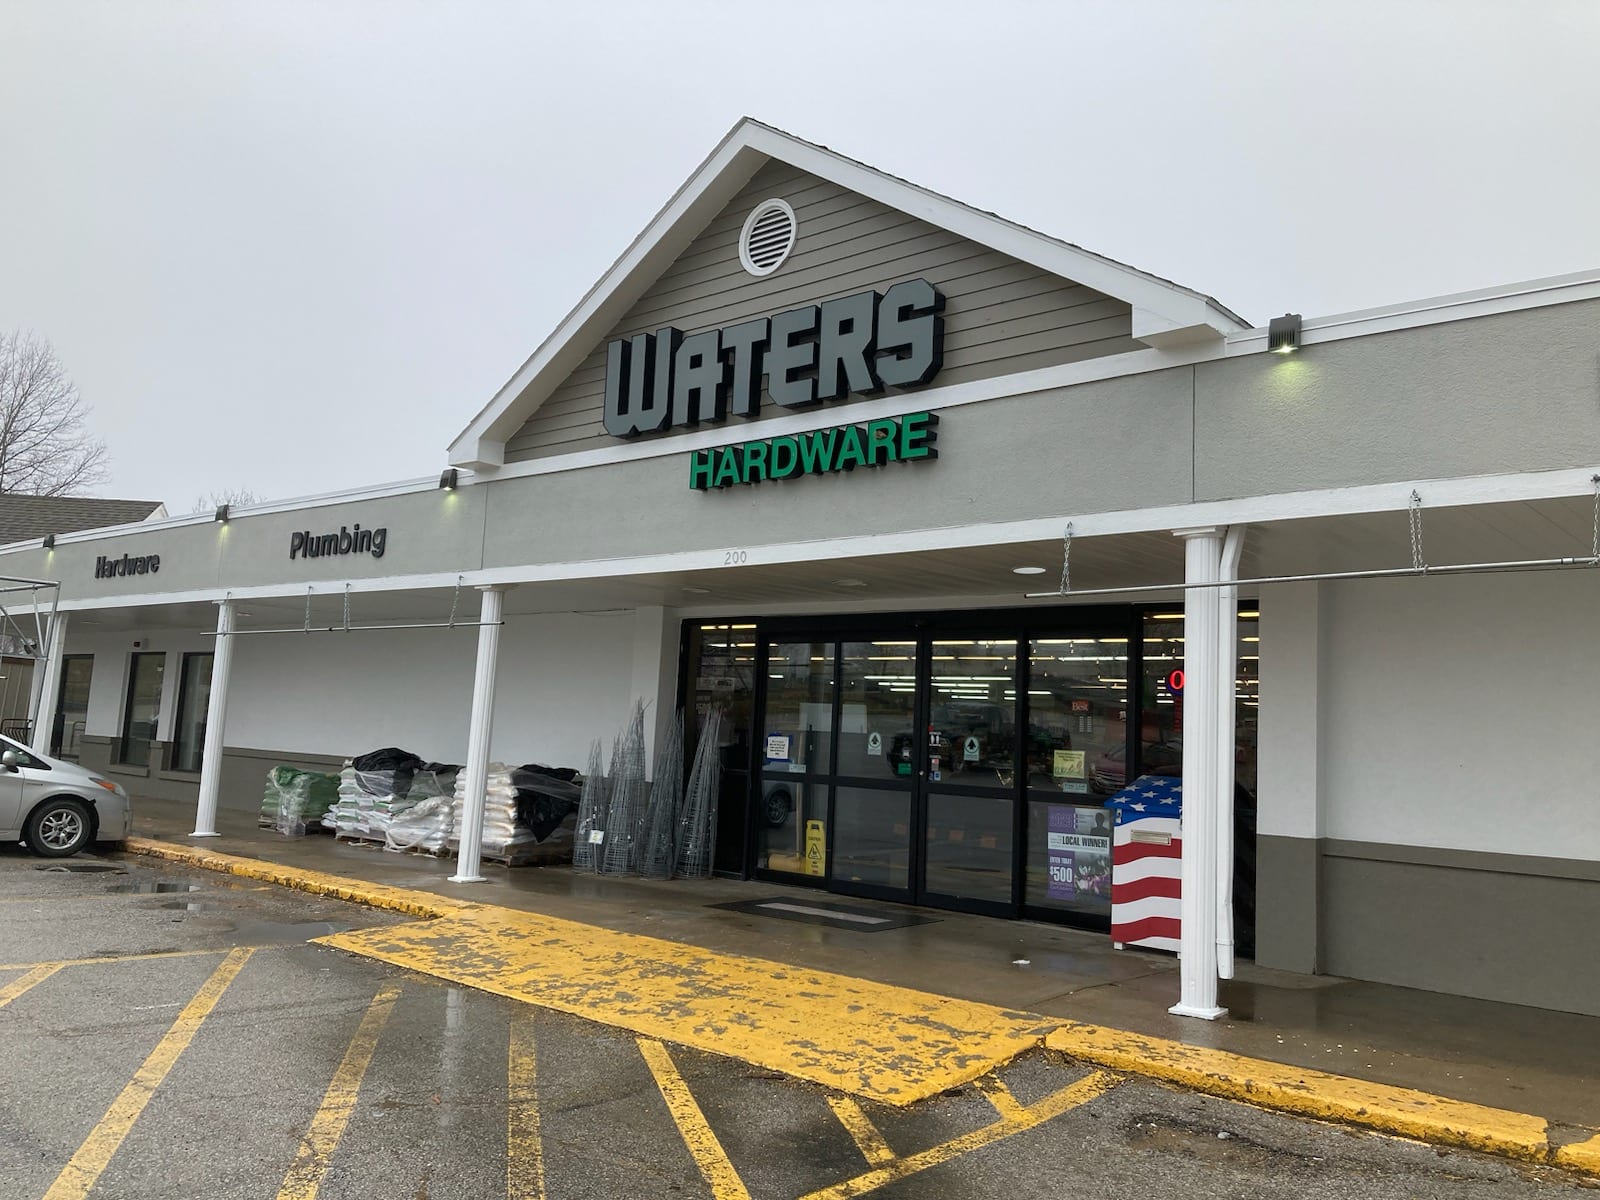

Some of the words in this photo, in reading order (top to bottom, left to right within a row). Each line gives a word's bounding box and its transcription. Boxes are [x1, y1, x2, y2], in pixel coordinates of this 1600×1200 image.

[602, 277, 946, 438] WATERS
[689, 411, 939, 490] HARDWARE
[289, 523, 388, 560] Plumbing
[95, 553, 161, 579] Hardware
[724, 550, 748, 566] 200
[1062, 835, 1080, 846] LOCAL
[1082, 837, 1108, 849] WINNER!
[1050, 866, 1073, 883] $500
